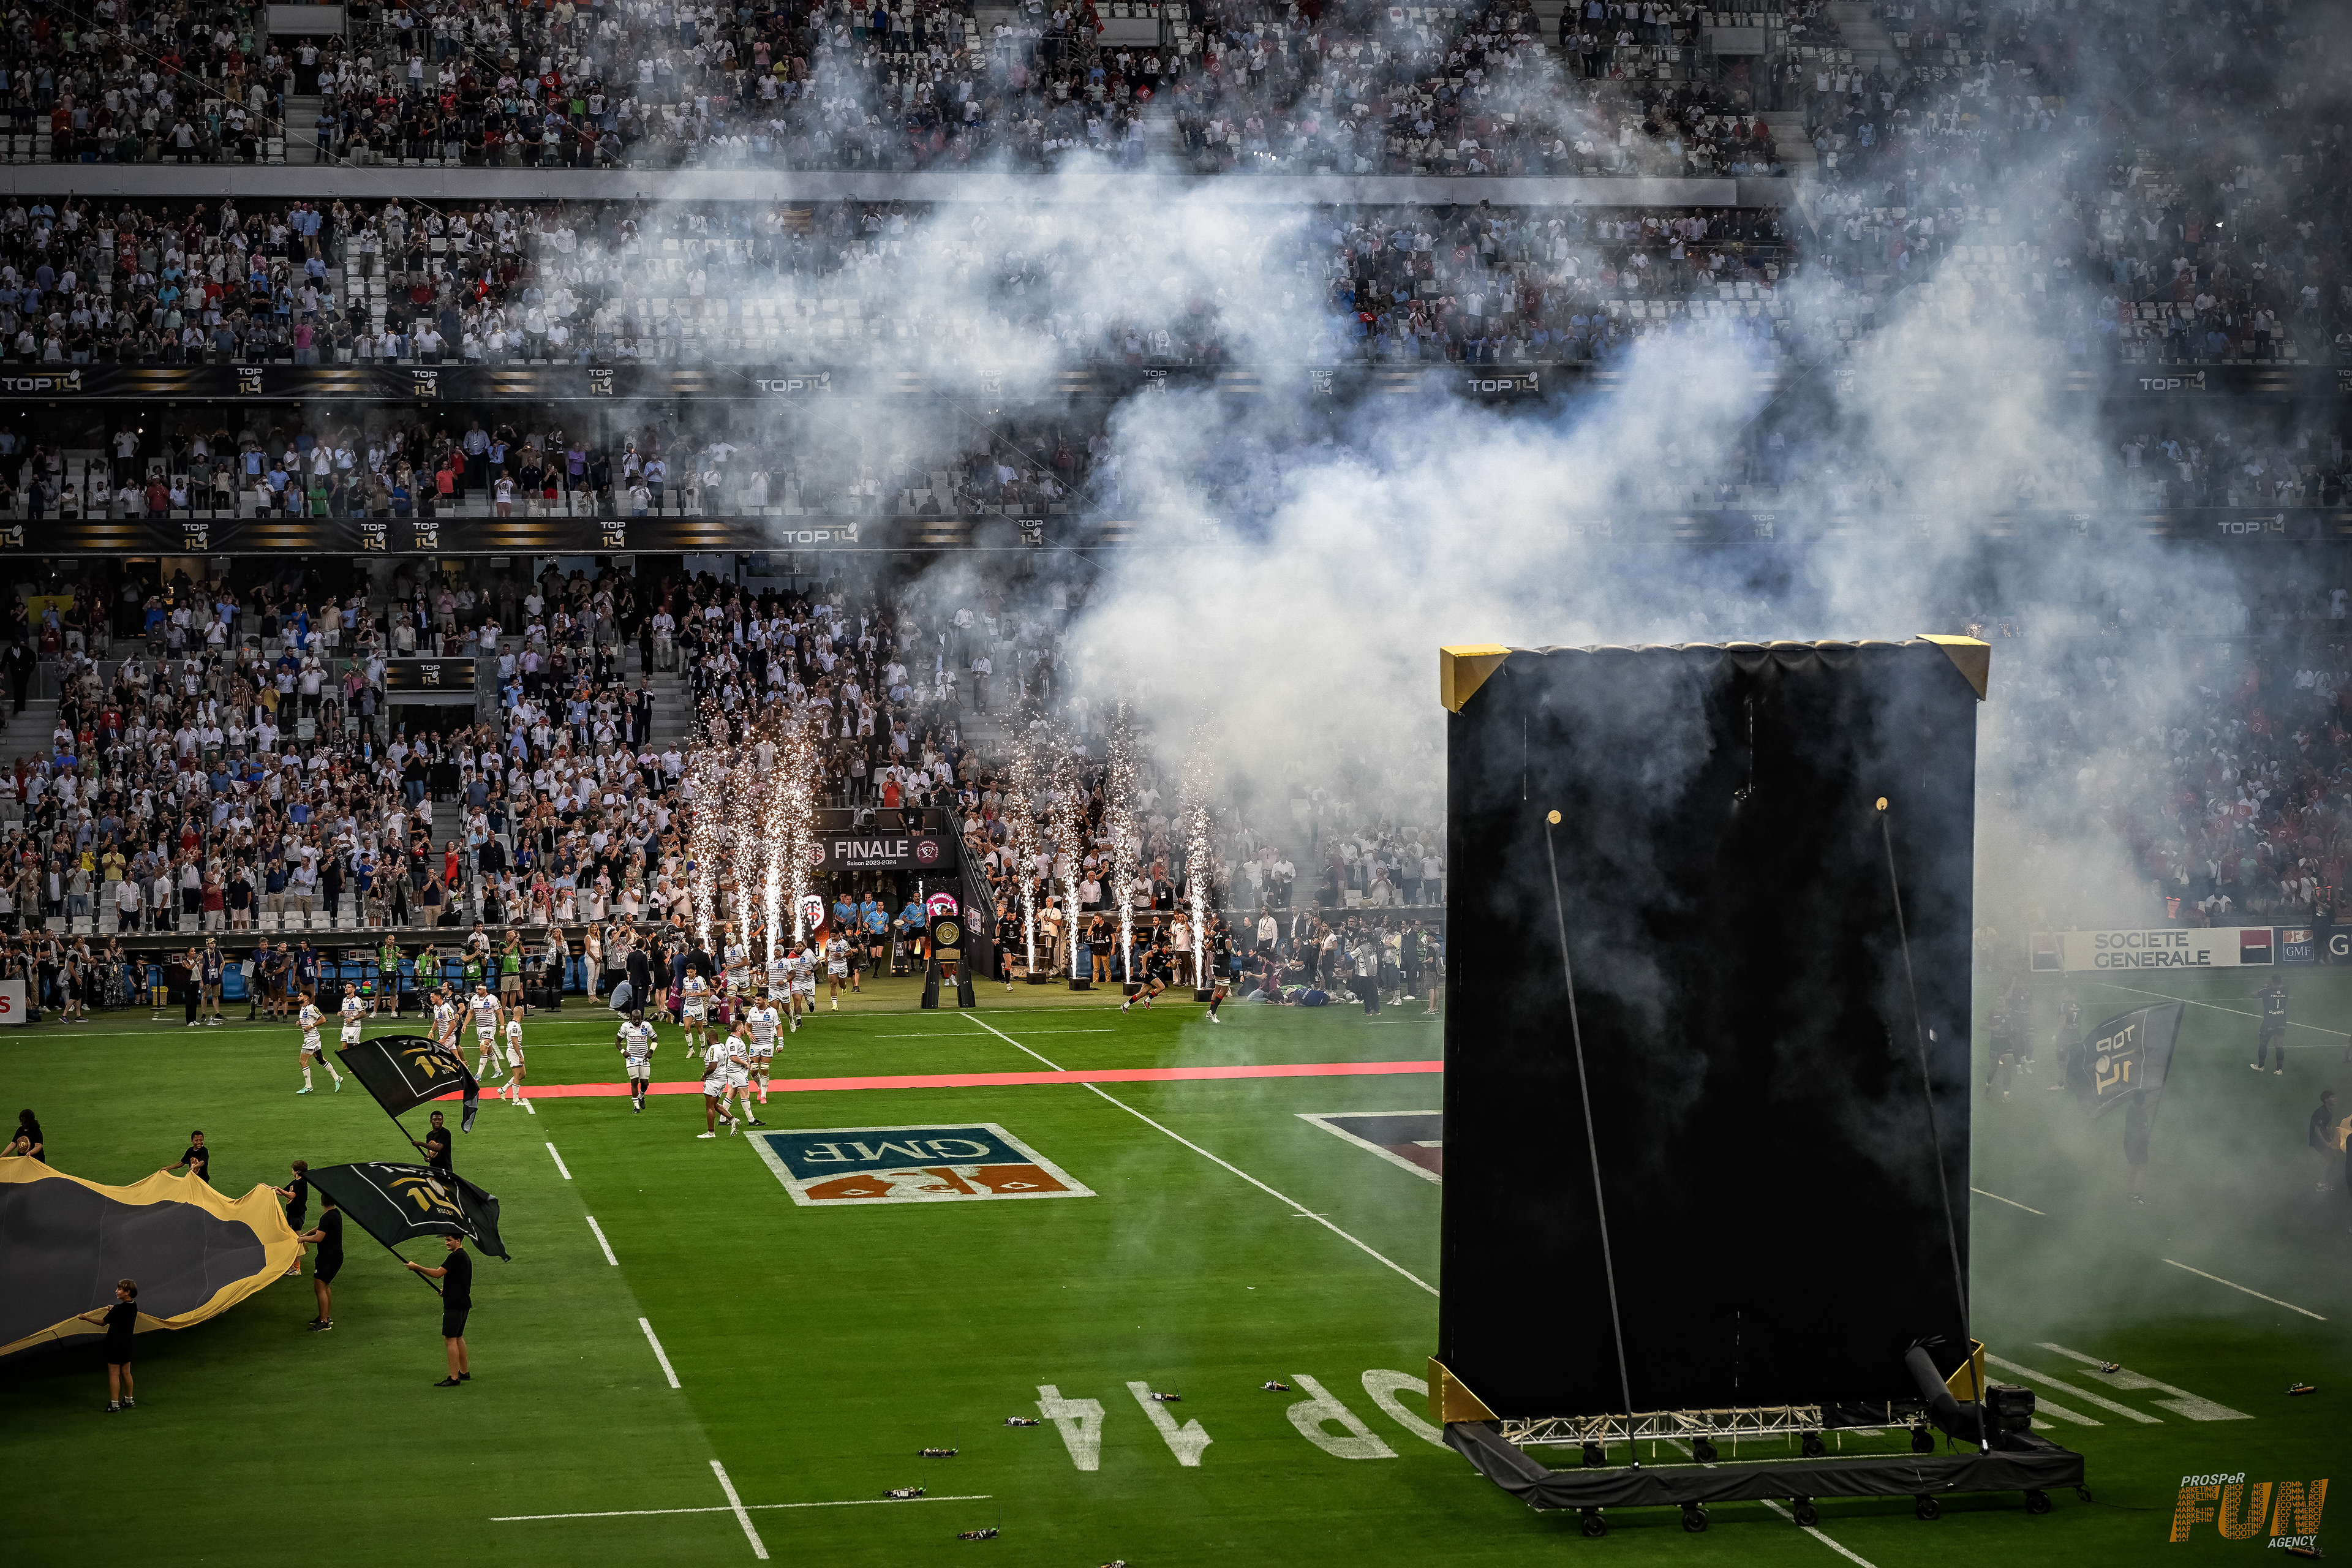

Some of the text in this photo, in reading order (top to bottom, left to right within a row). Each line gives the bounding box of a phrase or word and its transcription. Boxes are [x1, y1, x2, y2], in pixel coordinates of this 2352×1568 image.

[239, 383, 262, 393] 14
[413, 386, 436, 396] 14
[591, 383, 612, 394] 14
[185, 540, 207, 550] 14
[363, 539, 385, 550] 14
[415, 538, 437, 549] 14
[603, 537, 624, 548] 14
[422, 676, 439, 685] 14
[835, 840, 908, 858] FINALE
[2095, 931, 2189, 949] SOCIETE
[2286, 946, 2311, 956] GMF
[2095, 950, 2211, 968] GENERALE
[804, 1139, 990, 1162] GMF
[437, 1207, 454, 1216] RUGBY
